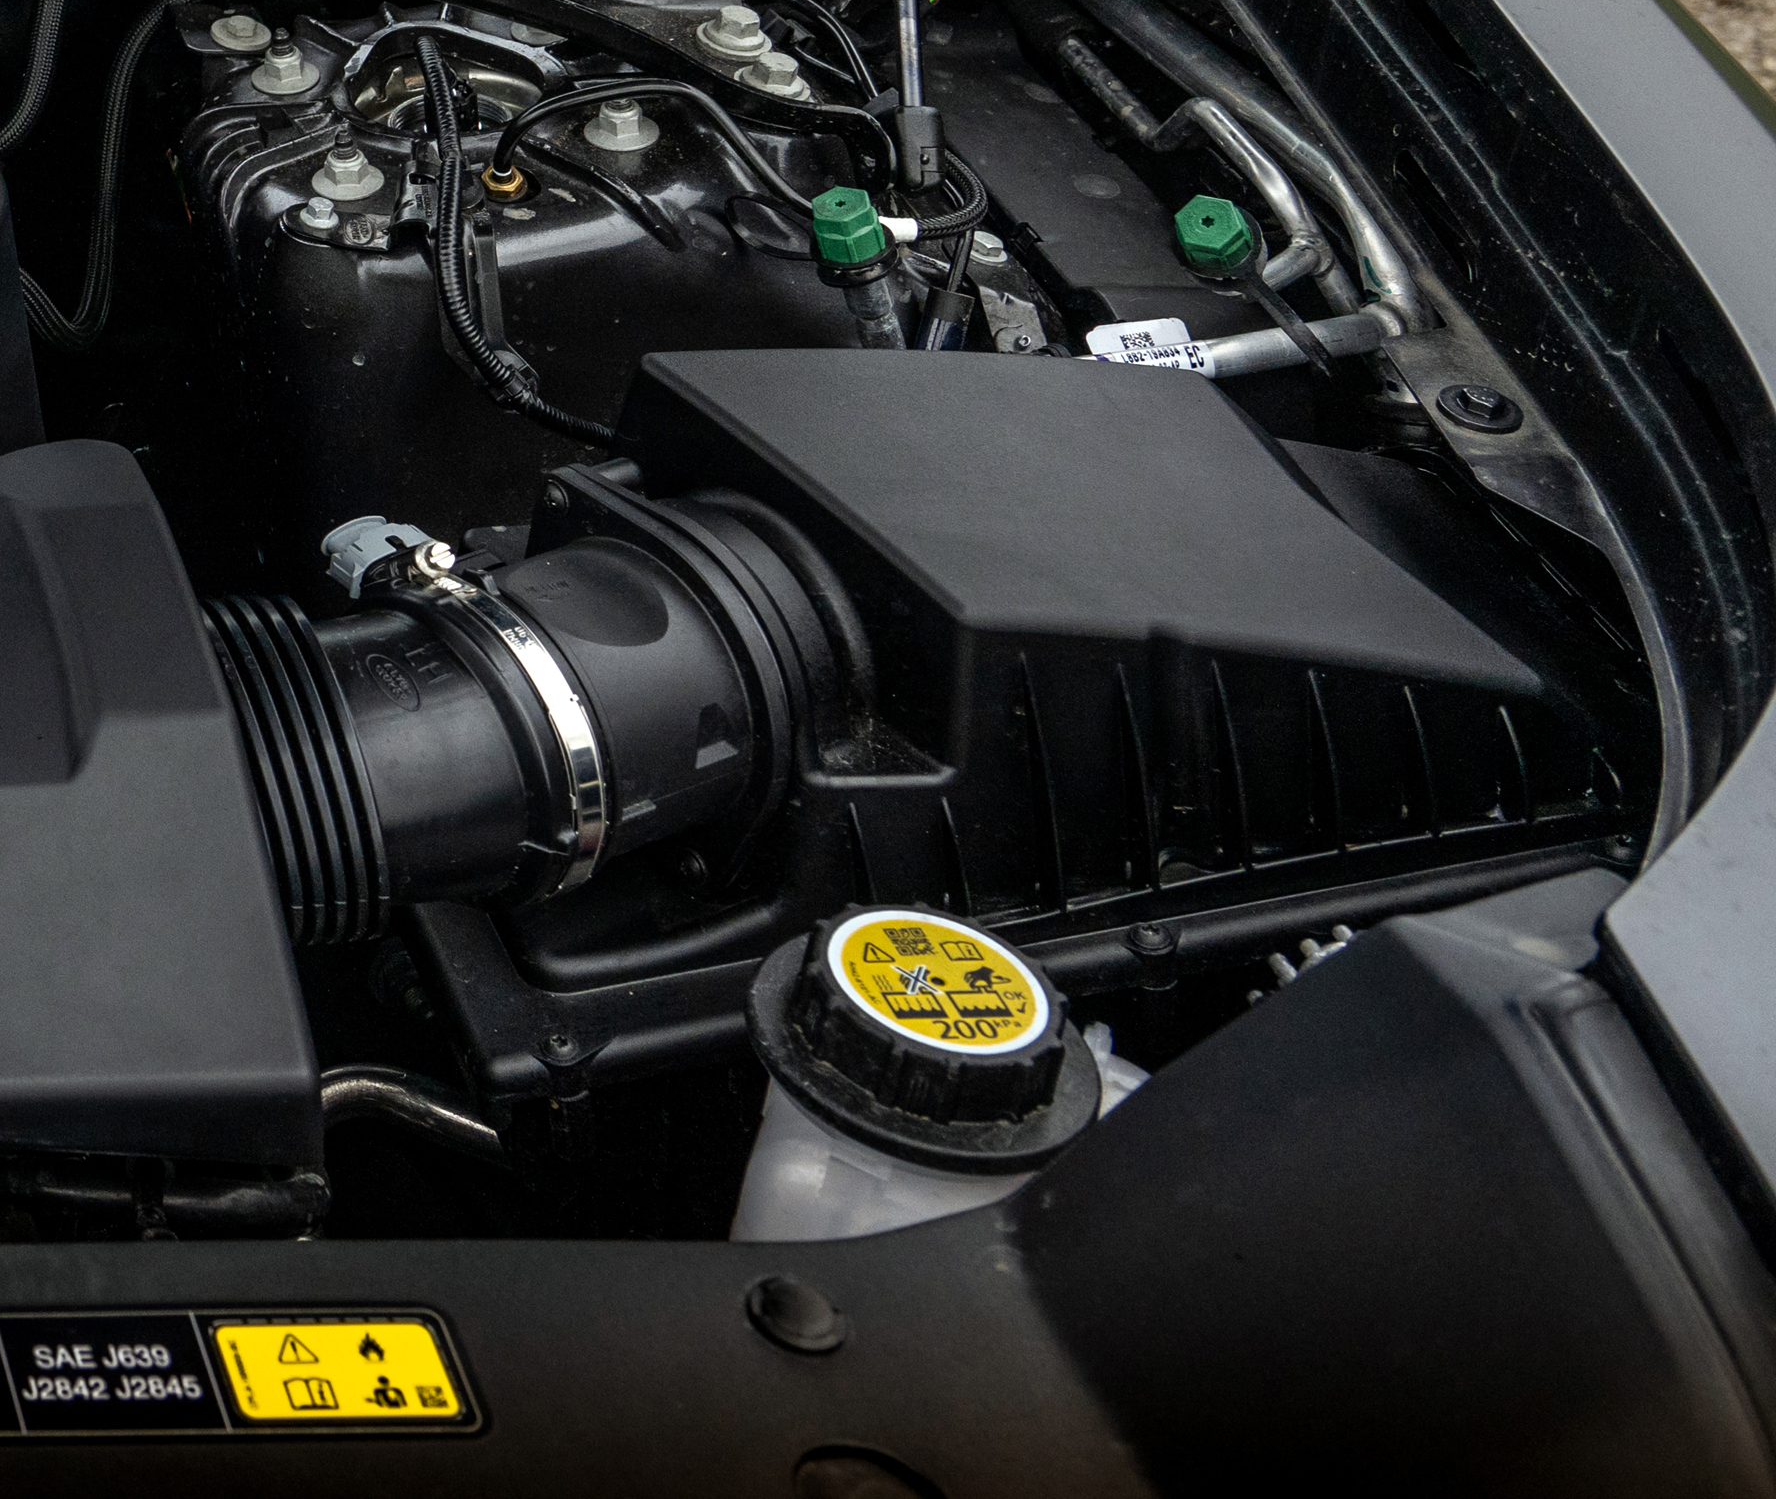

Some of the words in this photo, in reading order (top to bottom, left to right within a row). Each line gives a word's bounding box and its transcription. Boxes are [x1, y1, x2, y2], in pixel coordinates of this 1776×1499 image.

[1003, 991, 1027, 1001] OK
[932, 1019, 998, 1040] 200
[33, 1344, 97, 1370] SAE
[102, 1344, 172, 1370] J639
[21, 1375, 110, 1401] J2842
[114, 1374, 204, 1400] J2845
